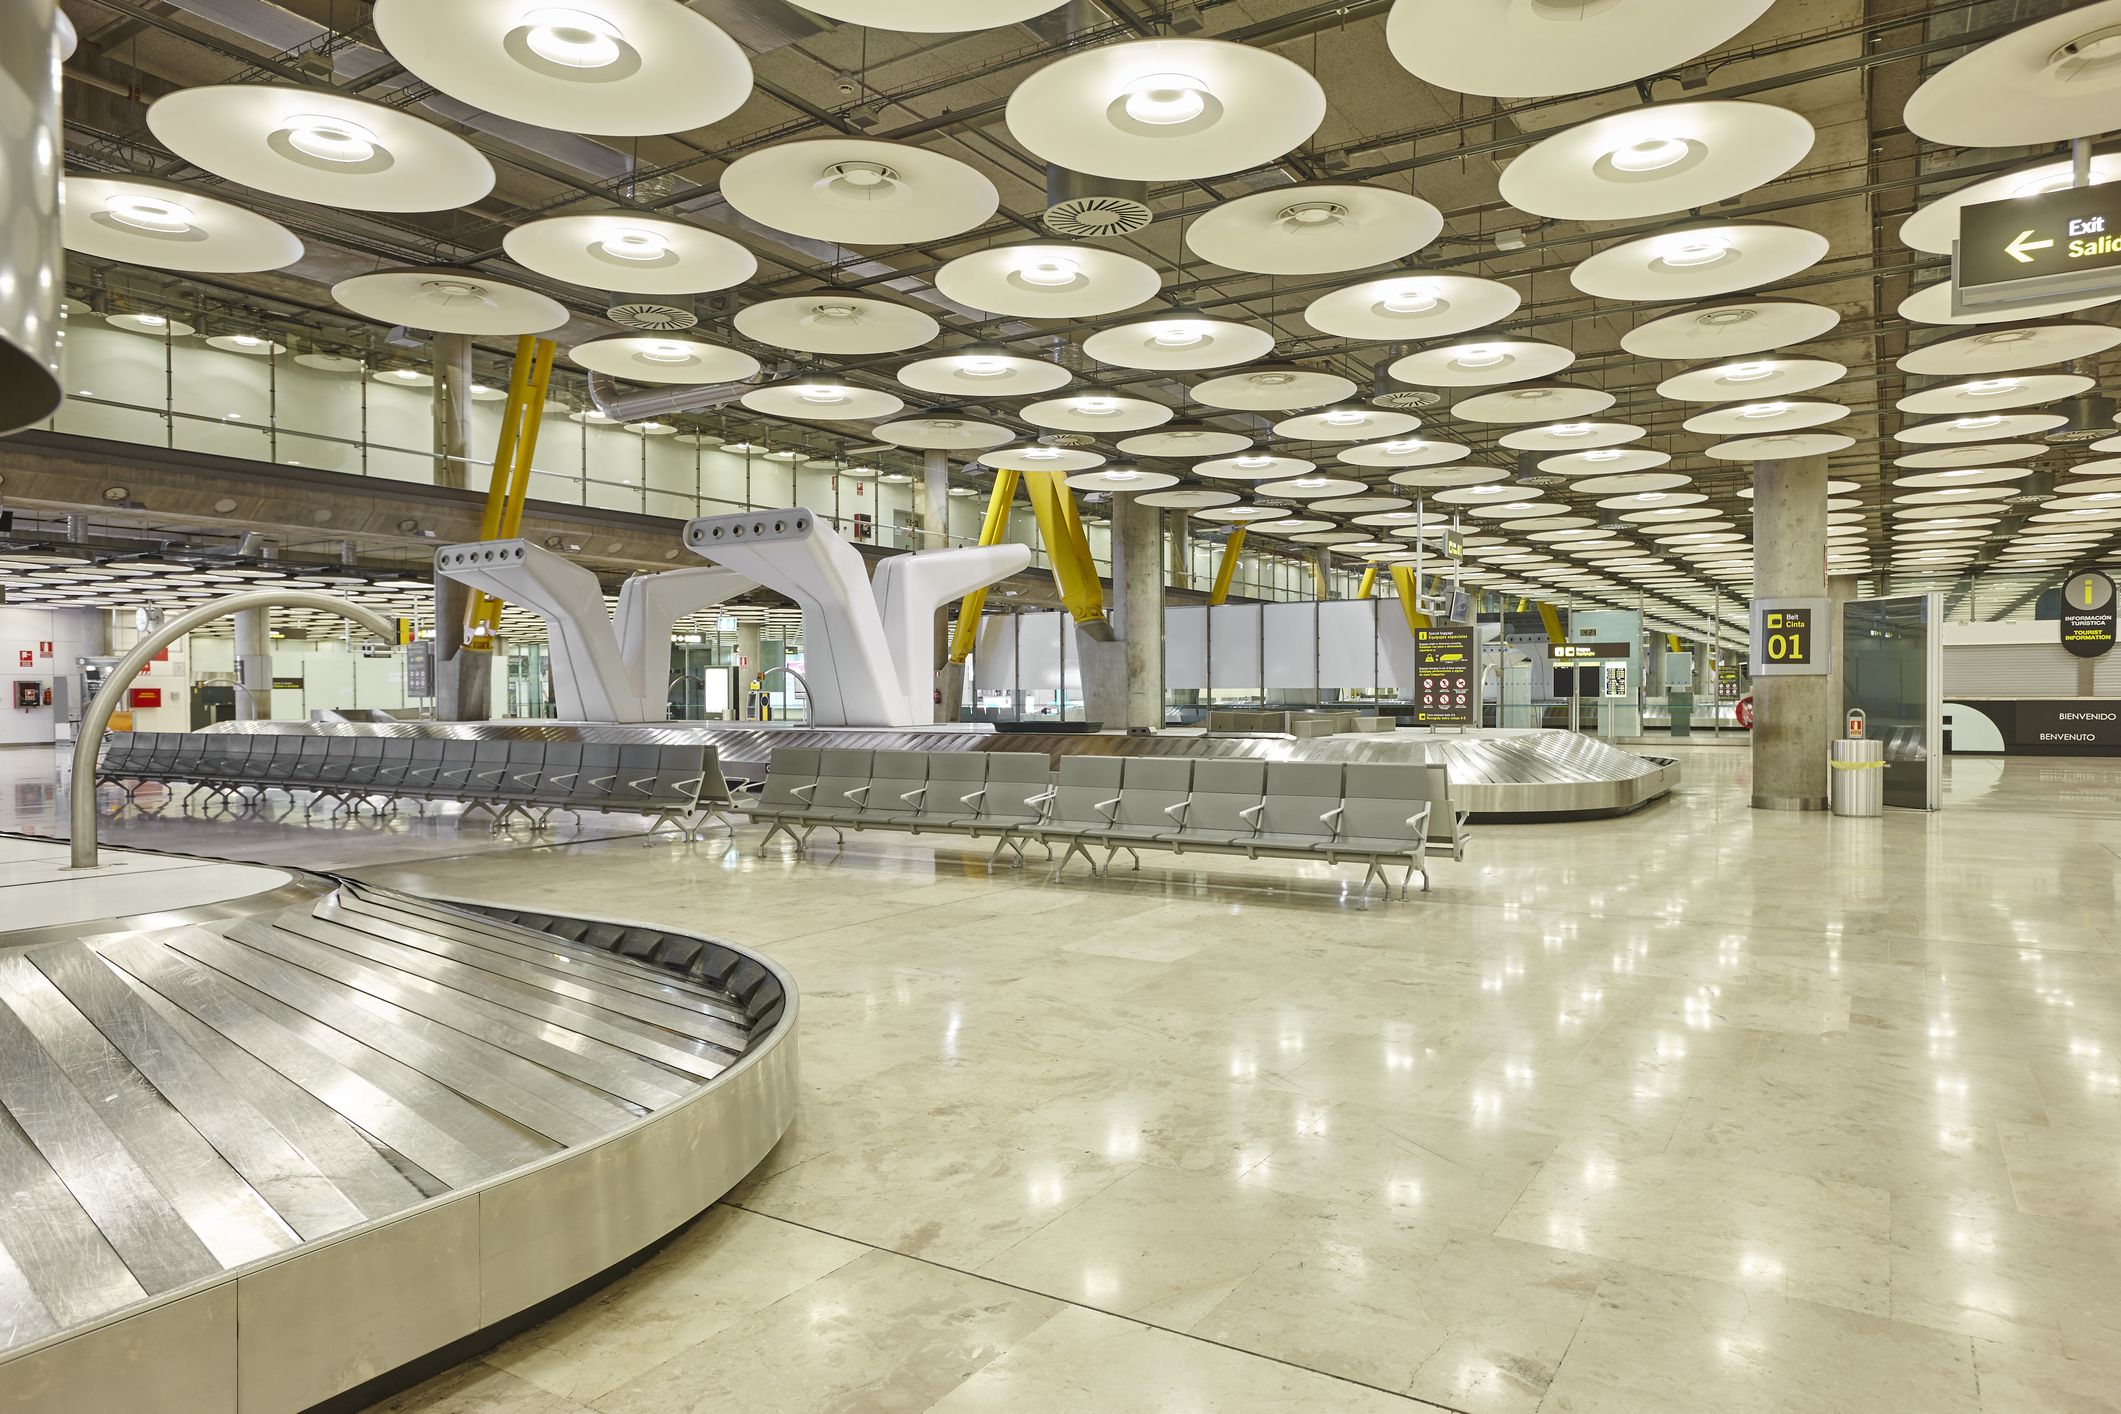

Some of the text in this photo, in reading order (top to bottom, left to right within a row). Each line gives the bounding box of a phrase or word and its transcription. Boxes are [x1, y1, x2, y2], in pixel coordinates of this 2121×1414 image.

[2068, 216, 2105, 236] Exit
[1767, 634, 1803, 659] 01
[2059, 712, 2117, 721] BIENVENIDO
[2040, 733, 2096, 742] BENVENUTO
